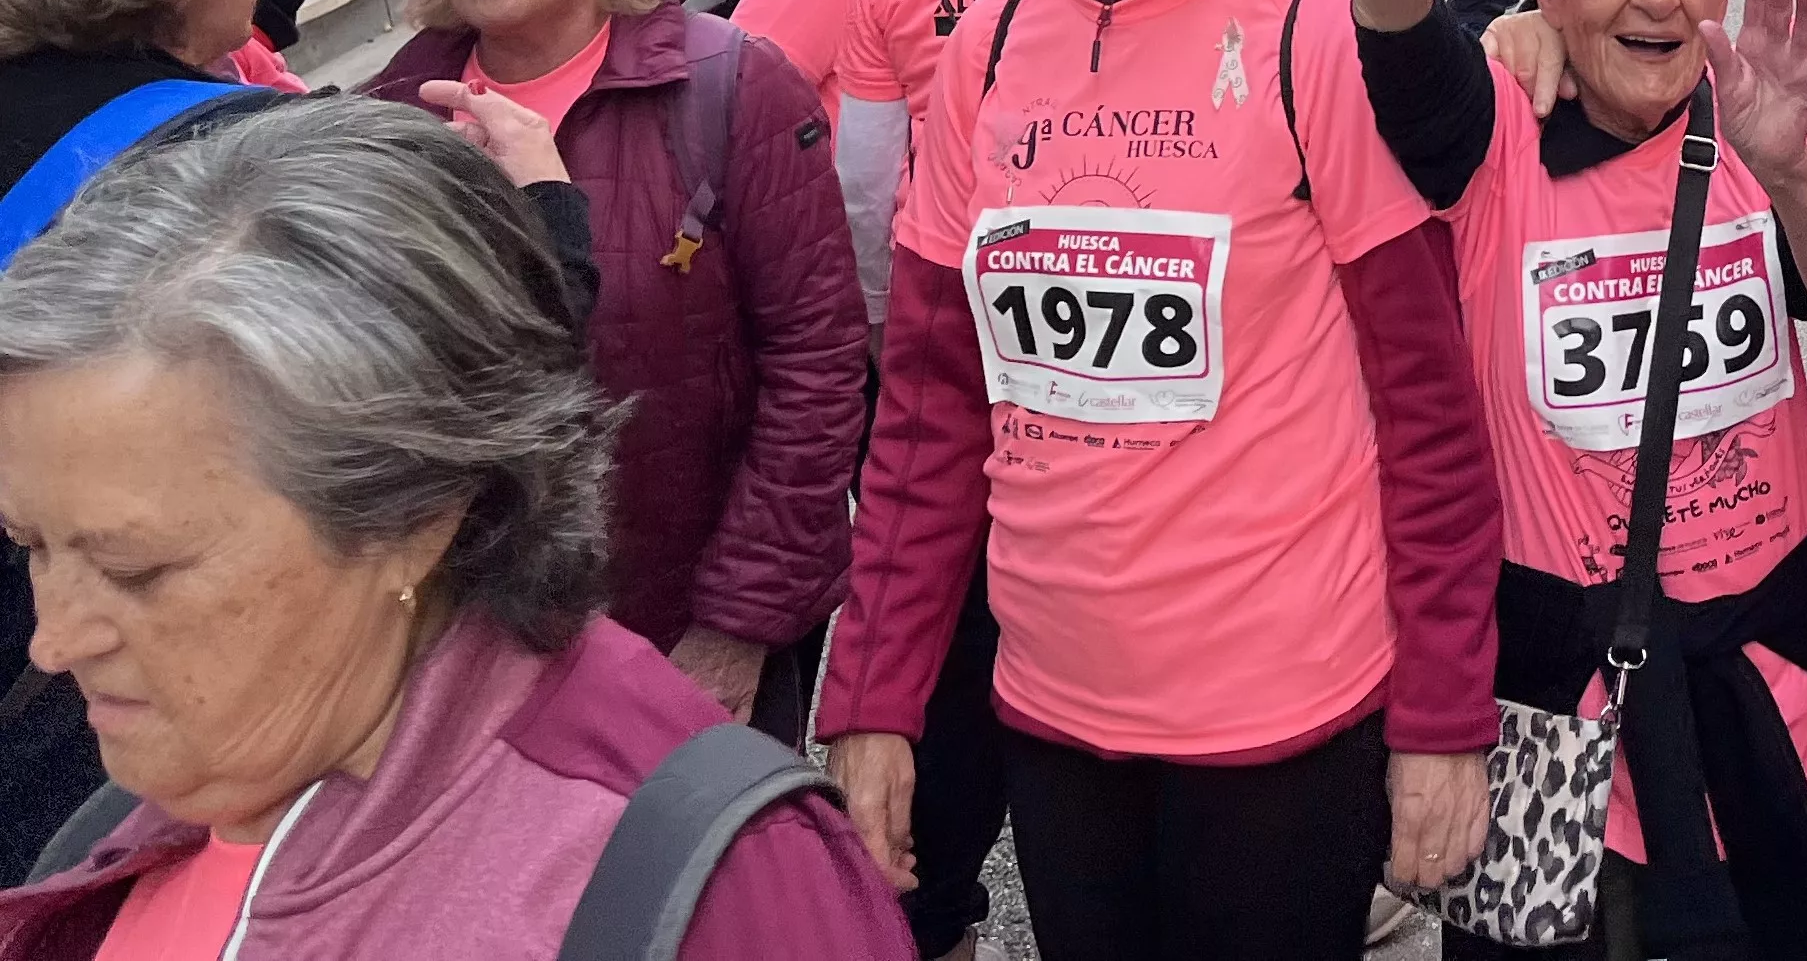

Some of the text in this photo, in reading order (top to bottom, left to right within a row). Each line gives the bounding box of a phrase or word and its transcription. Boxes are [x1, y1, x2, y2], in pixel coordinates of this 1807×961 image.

[1062, 104, 1195, 137] CÁNCER
[1126, 139, 1219, 159] HUESCA
[1057, 234, 1121, 252] HUESCA
[987, 251, 1196, 279] CONTRA EL CÁNCER
[1630, 256, 1667, 274] HUES
[1553, 279, 1643, 303] CONTRA
[1693, 257, 1755, 288] ÁNCER
[992, 285, 1198, 369] 1978
[1089, 394, 1138, 411] castellar
[1708, 479, 1771, 513] MUCHO
